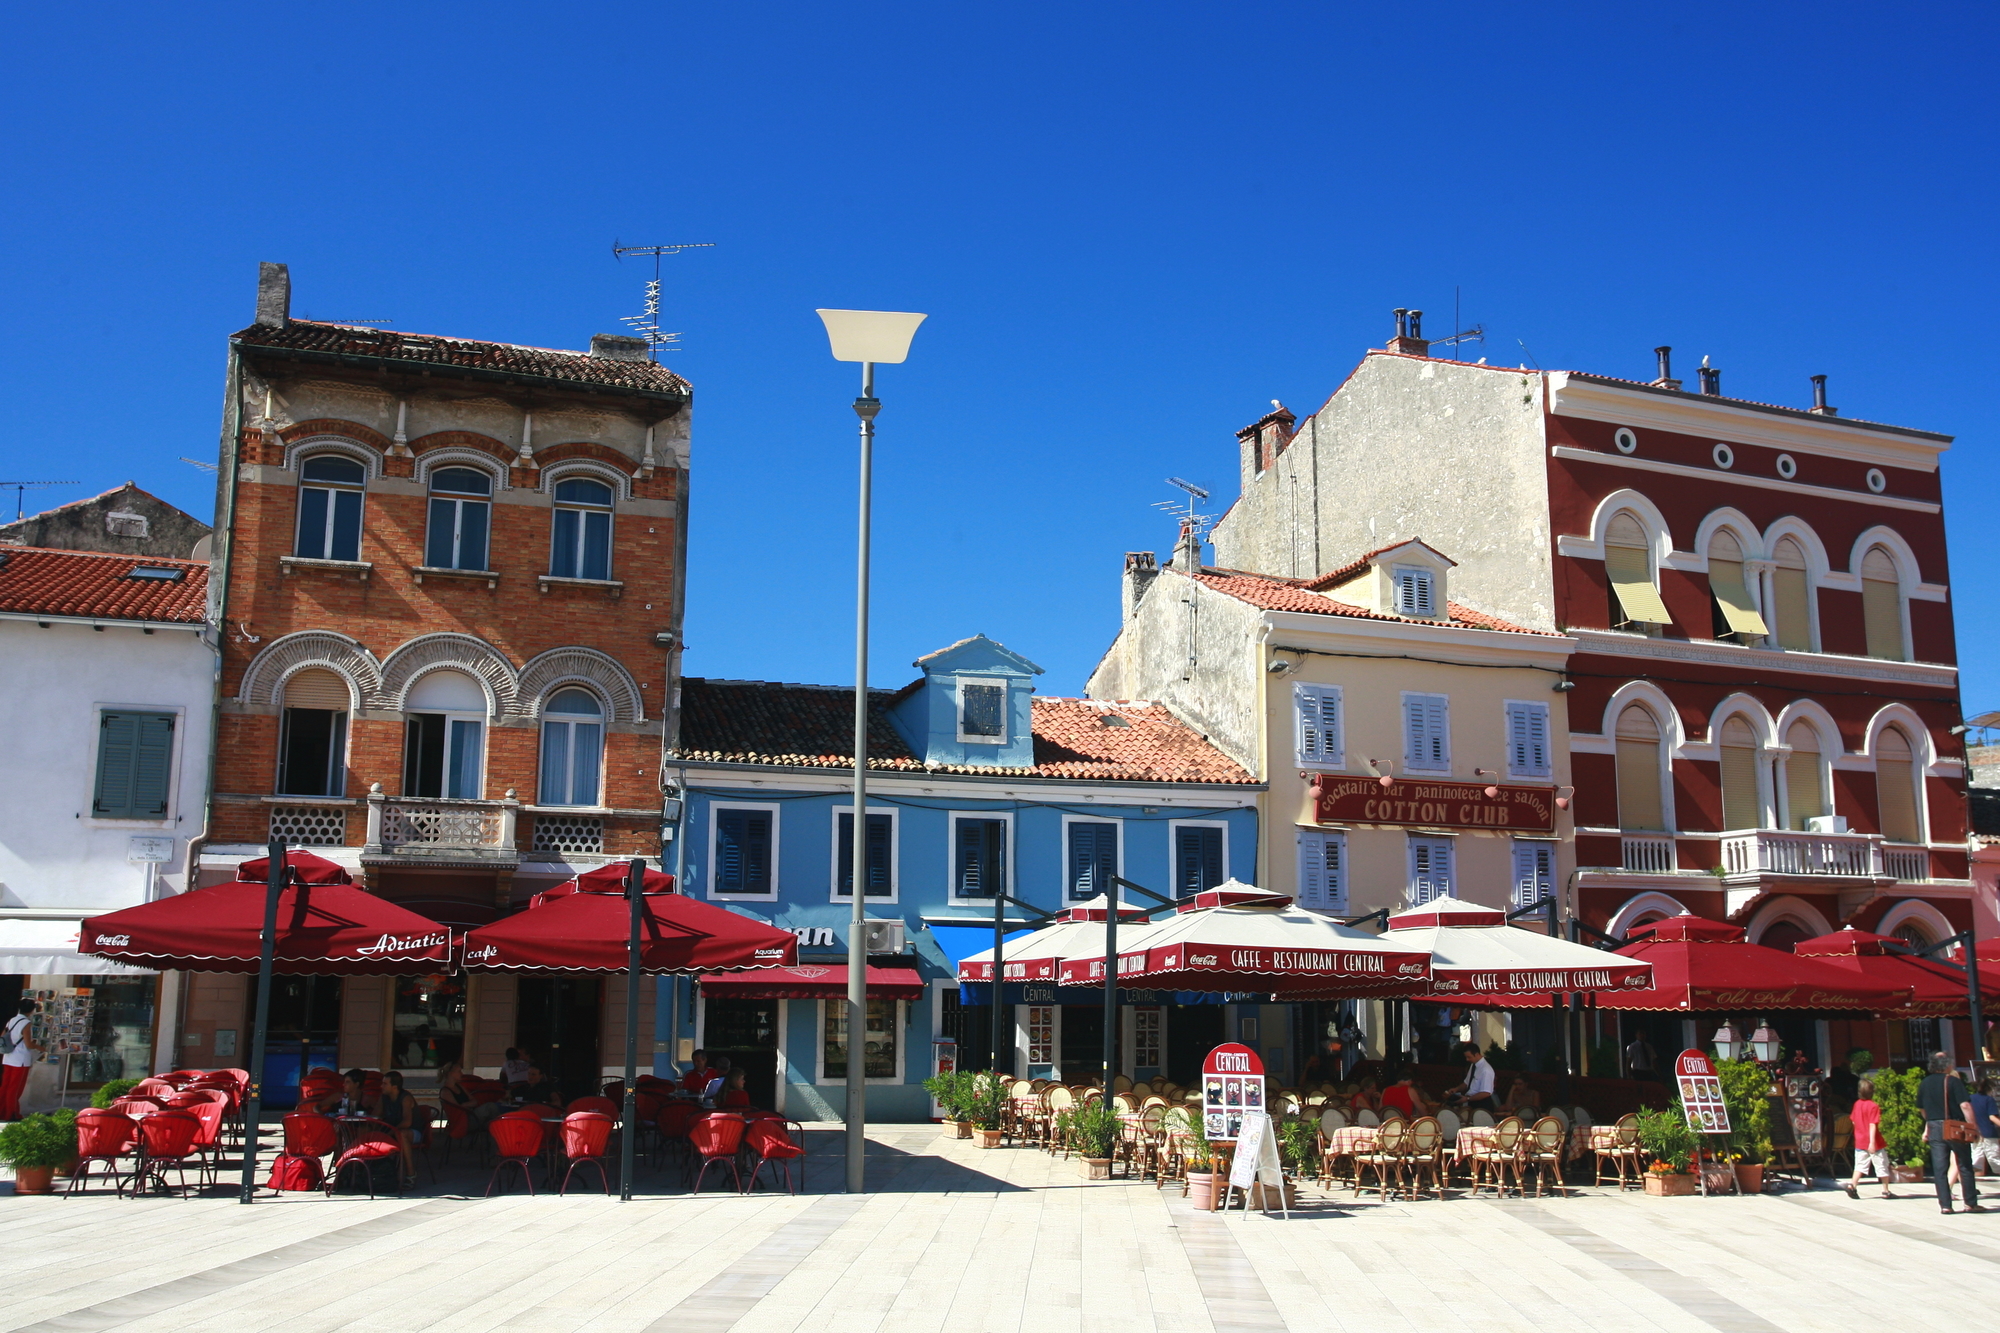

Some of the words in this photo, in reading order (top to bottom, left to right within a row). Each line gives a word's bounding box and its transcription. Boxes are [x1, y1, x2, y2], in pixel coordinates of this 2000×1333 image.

[1322, 781, 1377, 811] cocktail's
[1415, 786, 1482, 800] paninoteca
[1515, 791, 1550, 822] saloon
[1364, 799, 1448, 823] COTTON
[1459, 804, 1509, 825] CLUB
[356, 932, 445, 955] Adriatic
[467, 945, 498, 961] café
[754, 948, 784, 957] Aquarium
[1231, 949, 1261, 969] CAFFE
[1273, 951, 1339, 971] RESTAURANT
[1344, 953, 1386, 973] CENTRAL
[1471, 973, 1499, 990] CAFFE
[1509, 971, 1569, 990] RESTAURANT
[1573, 970, 1613, 988] CENTRAL
[1023, 984, 1056, 1002] CENTRAL
[1126, 989, 1157, 1003] CENTRAL
[1716, 989, 1746, 1005] Old
[1751, 987, 1797, 1004] Pub
[1809, 990, 1859, 1004] Cotton
[1215, 1051, 1251, 1072] CENTRAL
[1683, 1056, 1710, 1074] CENTRAL
